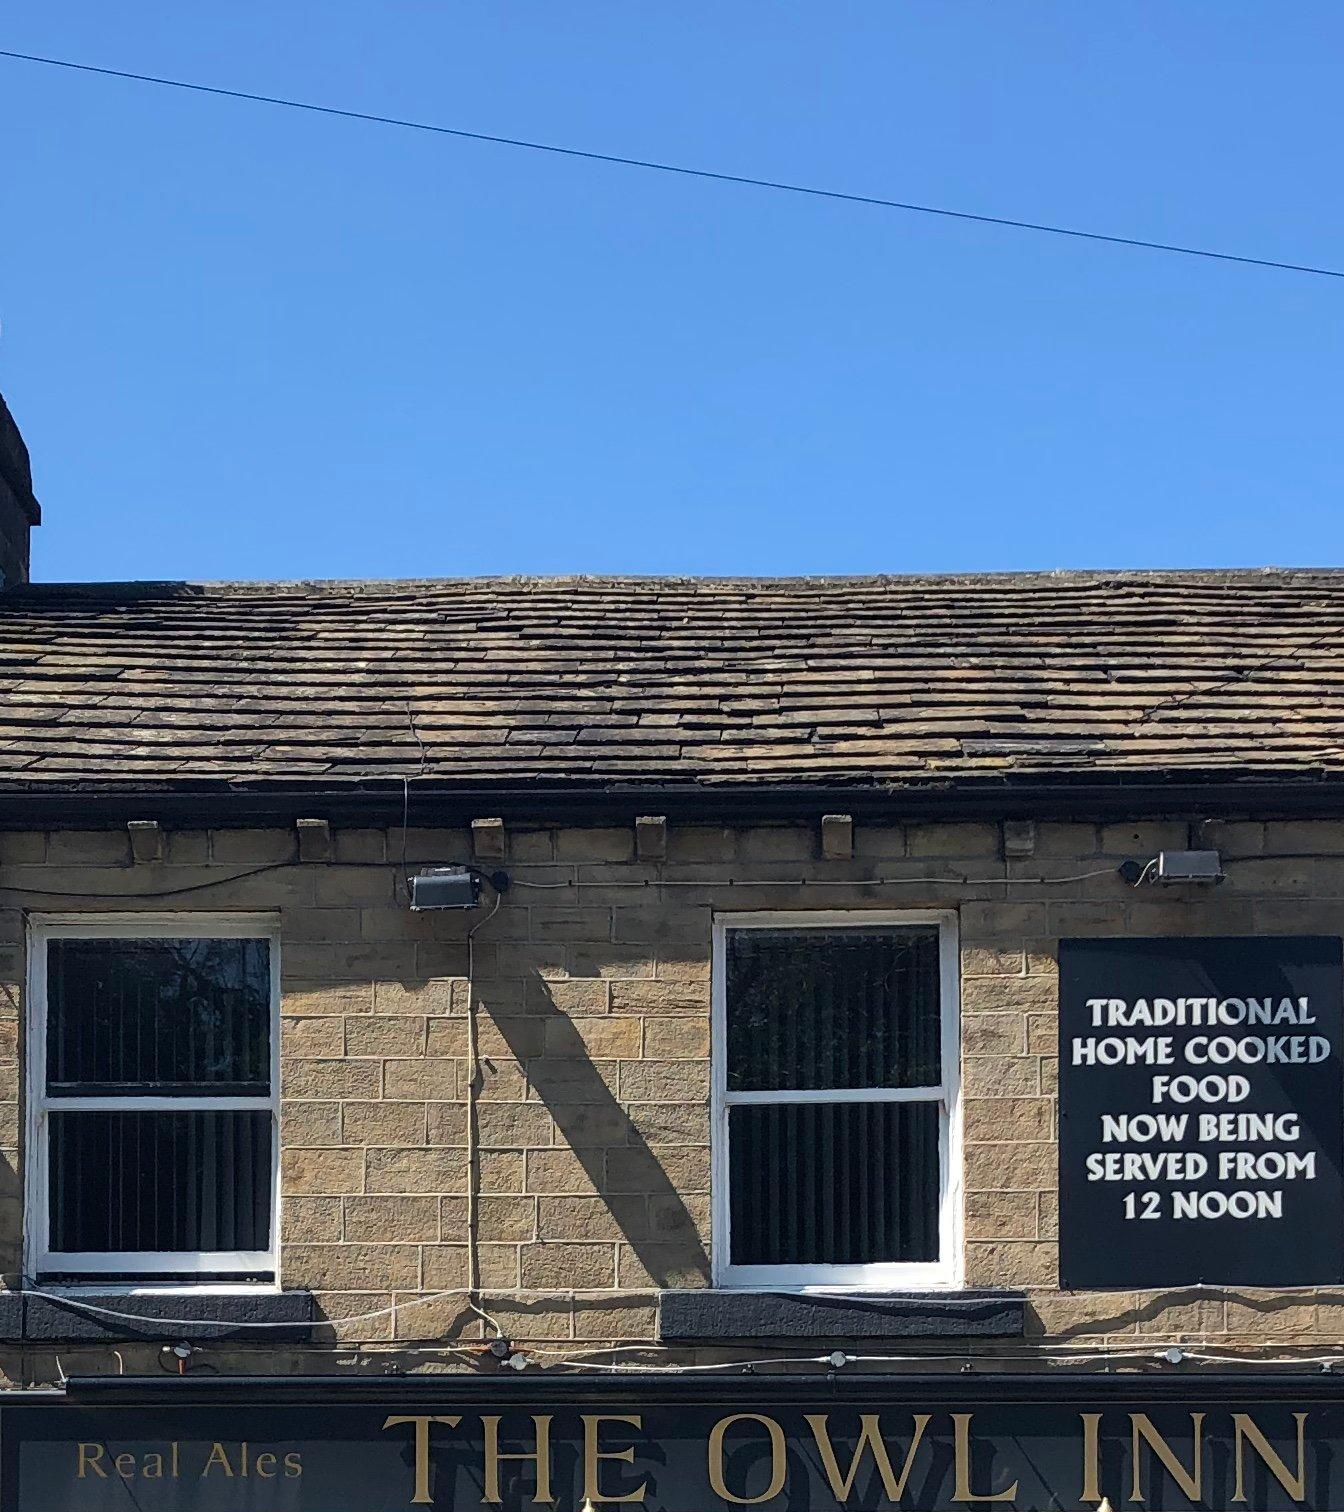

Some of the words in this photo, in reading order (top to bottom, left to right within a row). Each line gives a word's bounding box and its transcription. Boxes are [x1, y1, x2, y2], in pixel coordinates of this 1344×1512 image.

[1085, 996, 1317, 1027] TRADITIONAL
[1071, 1036, 1176, 1066] HOME
[1184, 1035, 1332, 1064] COOKED
[1152, 1074, 1251, 1104] FOOD
[1101, 1114, 1189, 1143] NOW
[1198, 1113, 1301, 1142] BEING
[1085, 1152, 1208, 1181] SERVED
[1218, 1151, 1317, 1180] FROM
[1122, 1192, 1162, 1220] 12
[1171, 1191, 1283, 1219] NOON
[76, 1441, 181, 1479] Real
[200, 1441, 305, 1479] Ales
[381, 1414, 650, 1504] THE
[706, 1412, 1019, 1503] OWL
[1078, 1411, 1309, 1503] INN
